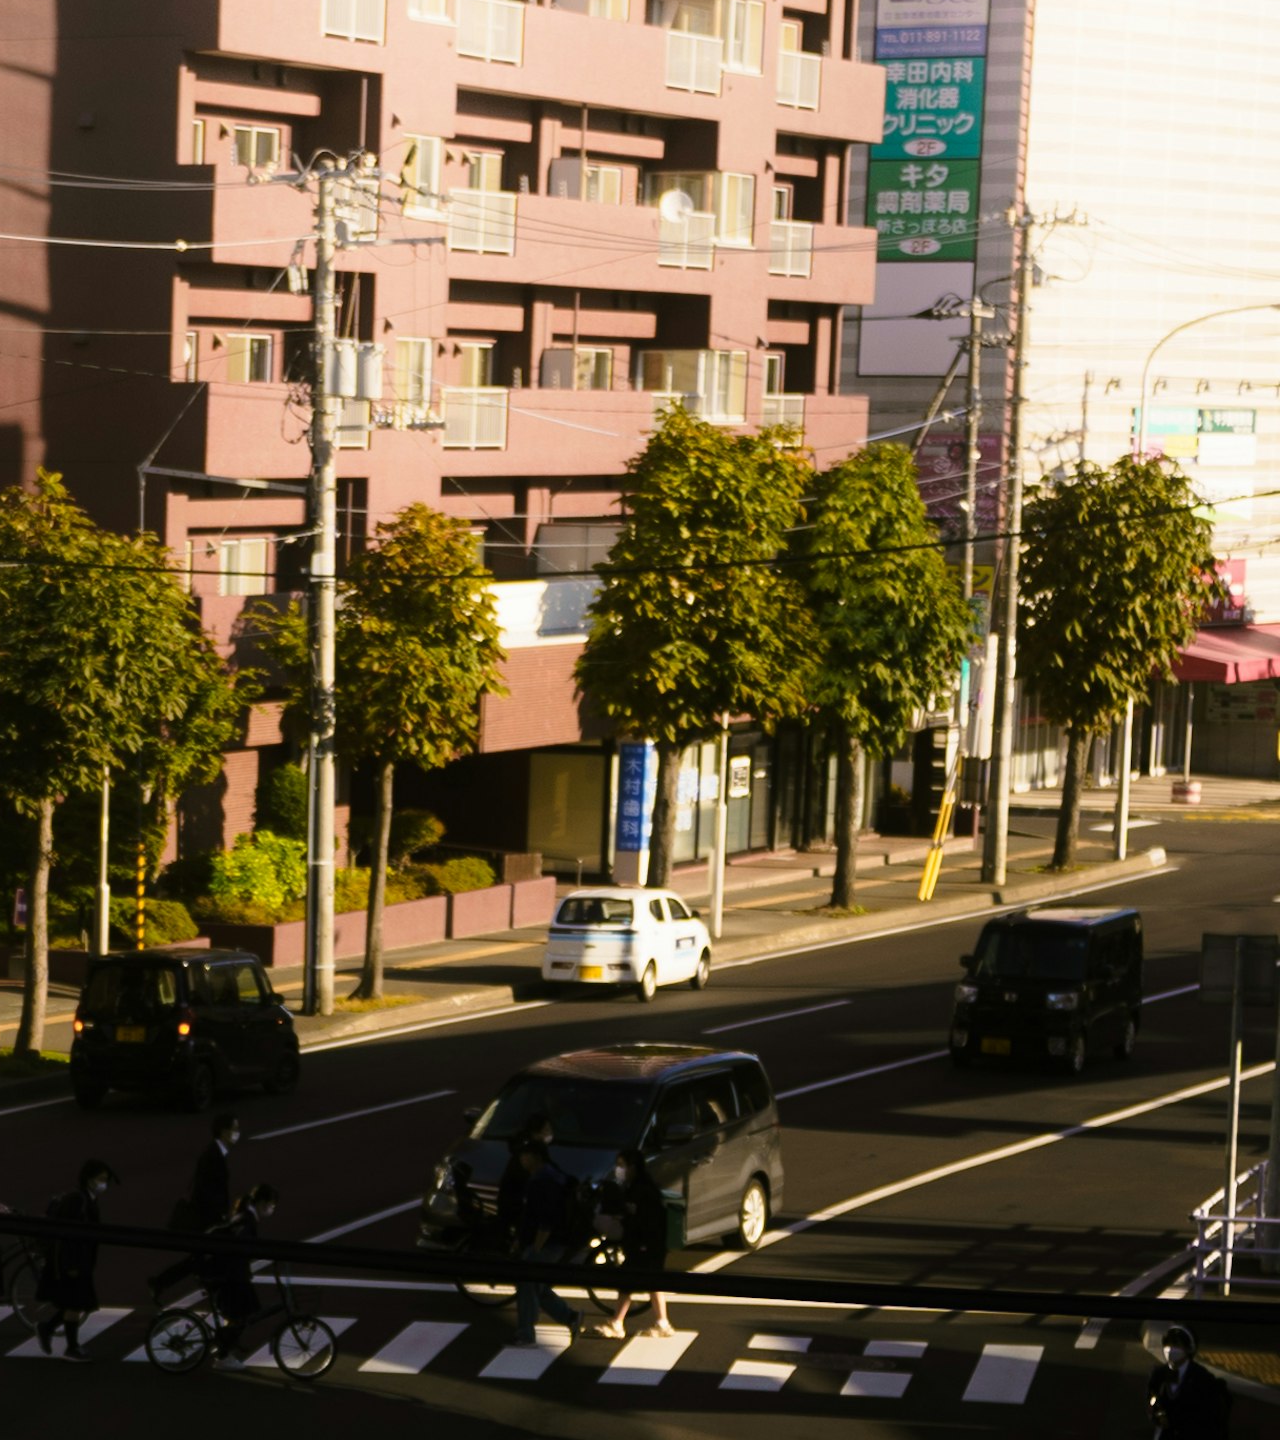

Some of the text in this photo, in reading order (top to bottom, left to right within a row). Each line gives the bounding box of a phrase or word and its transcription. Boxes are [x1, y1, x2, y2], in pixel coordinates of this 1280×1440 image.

[887, 61, 974, 84] 幸田内科
[896, 87, 959, 109] 消化器
[883, 113, 975, 136] クリニック
[916, 141, 937, 154] 2F
[900, 164, 949, 188] キタ
[877, 191, 970, 214] 調剤薬局
[911, 241, 931, 254] 2F
[622, 760, 642, 838] 木村歯科
